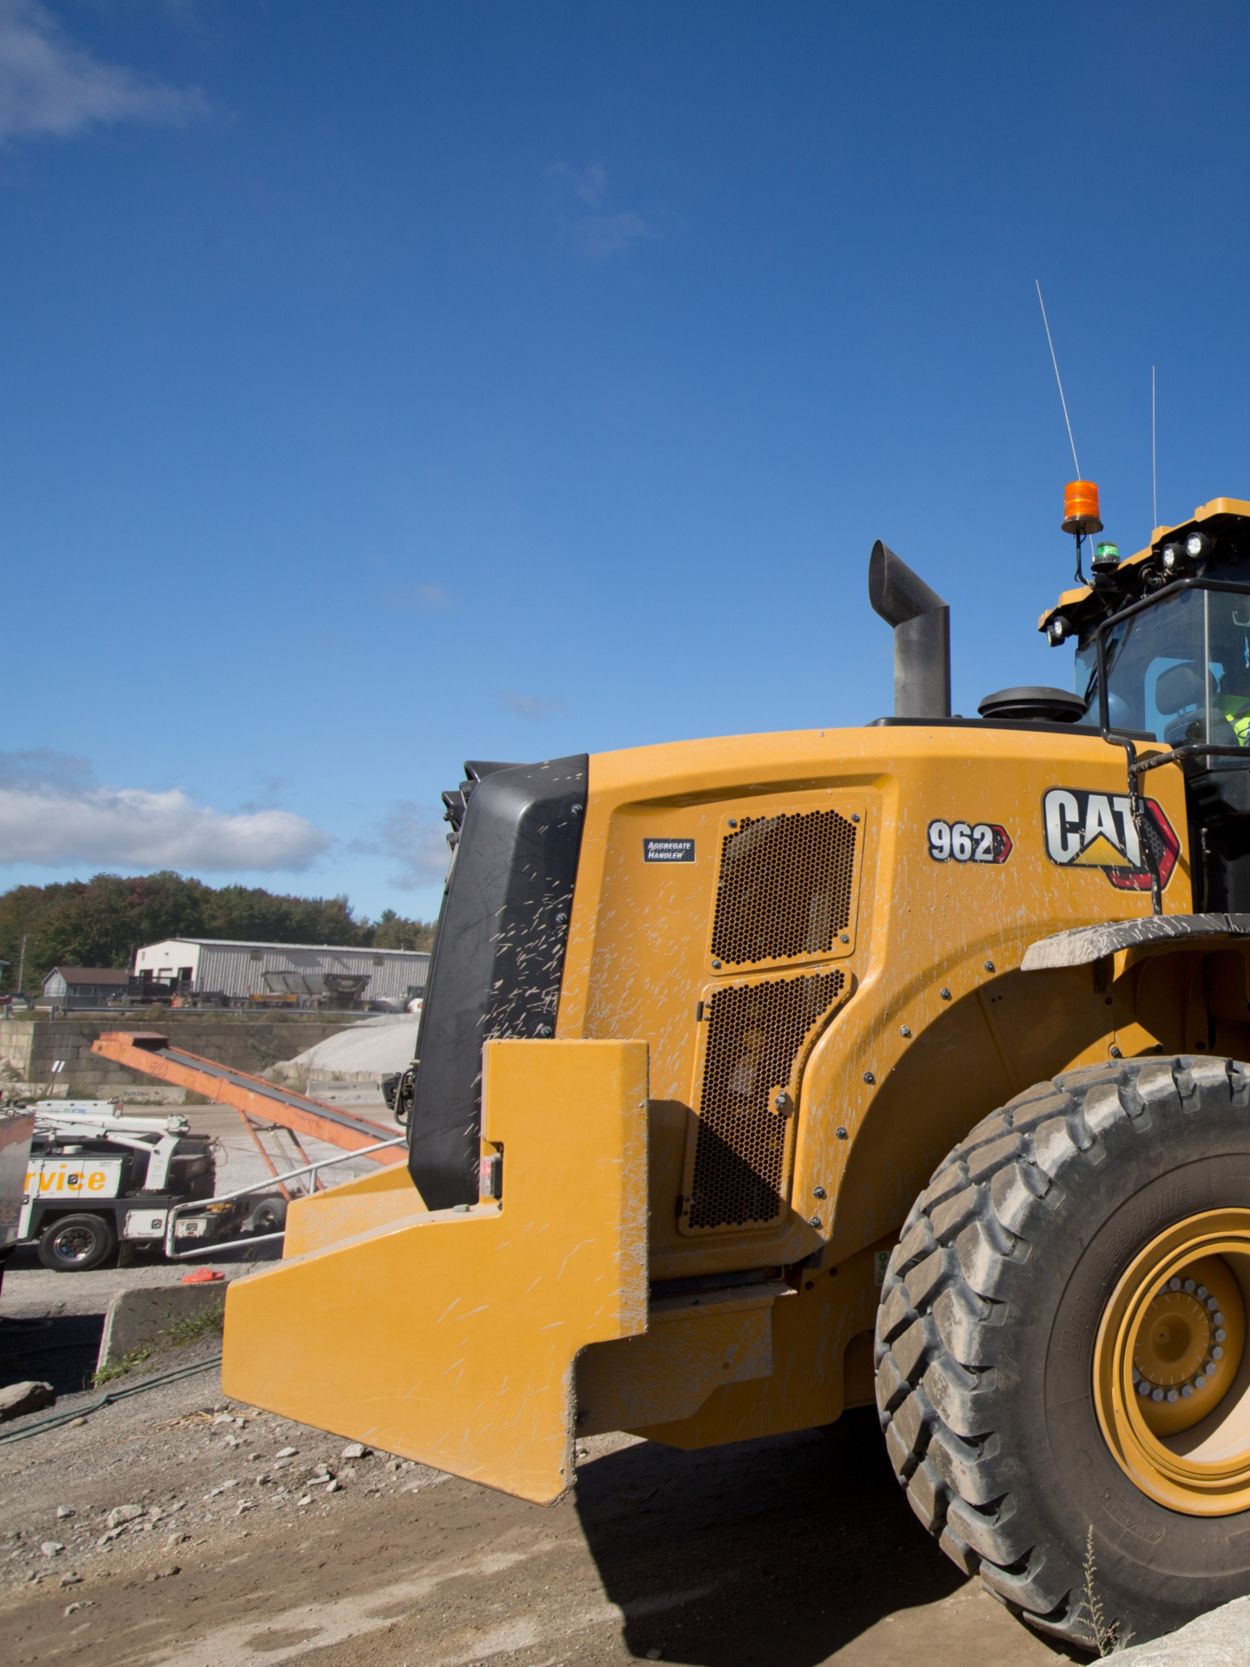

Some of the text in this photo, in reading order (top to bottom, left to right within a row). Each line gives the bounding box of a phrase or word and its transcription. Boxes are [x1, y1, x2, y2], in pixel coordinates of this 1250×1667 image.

[1045, 790, 1144, 867] CAT
[648, 841, 691, 849] AGGREGATE
[929, 821, 993, 861] 962
[648, 851, 684, 859] HANDLER
